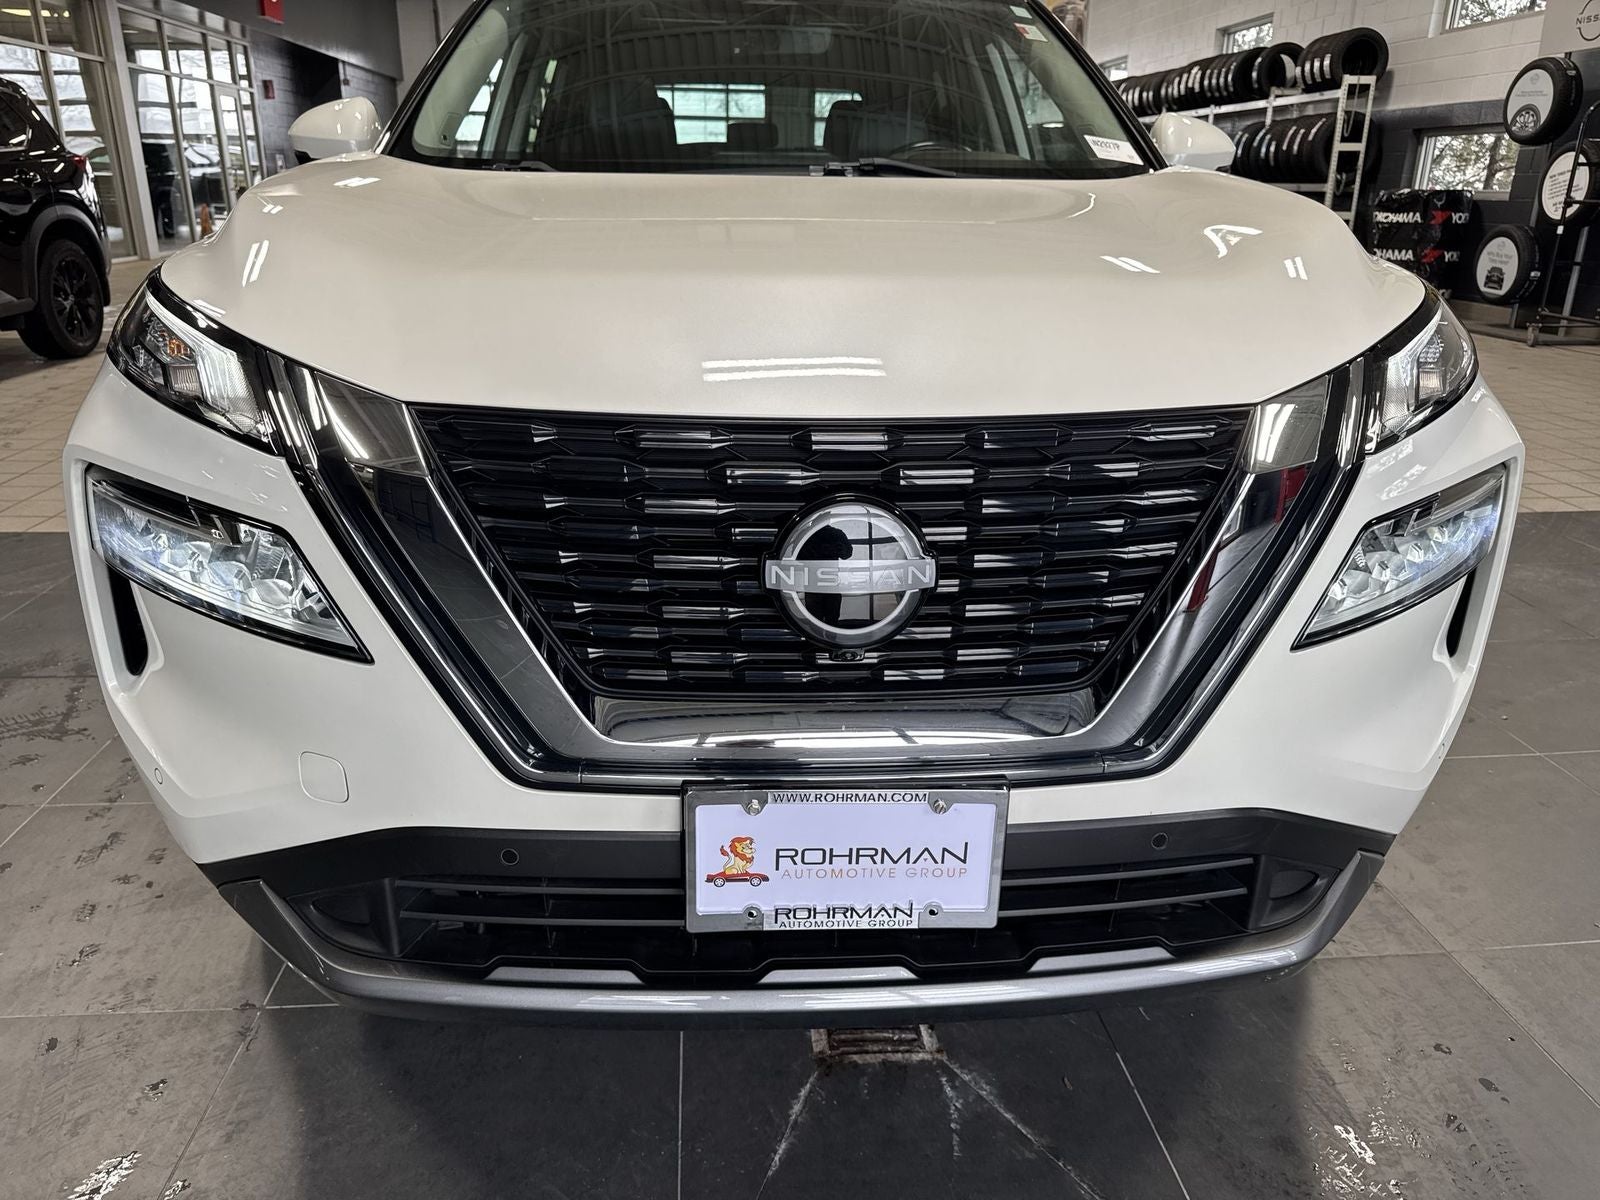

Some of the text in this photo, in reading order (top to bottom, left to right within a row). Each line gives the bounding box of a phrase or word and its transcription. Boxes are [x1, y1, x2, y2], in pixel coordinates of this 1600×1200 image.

[1576, 14, 1600, 26] NISS
[1373, 211, 1422, 223] OKOHAMA
[771, 565, 930, 586] NISSAN
[774, 792, 928, 804] WWW.ROHRMAN.COM
[775, 842, 968, 871] ROHRMAN
[781, 867, 968, 880] AUTOMOTIVE GROUP
[774, 901, 913, 924] ROHRMAN
[779, 919, 913, 929] AUTOMOTIVE GROUP
